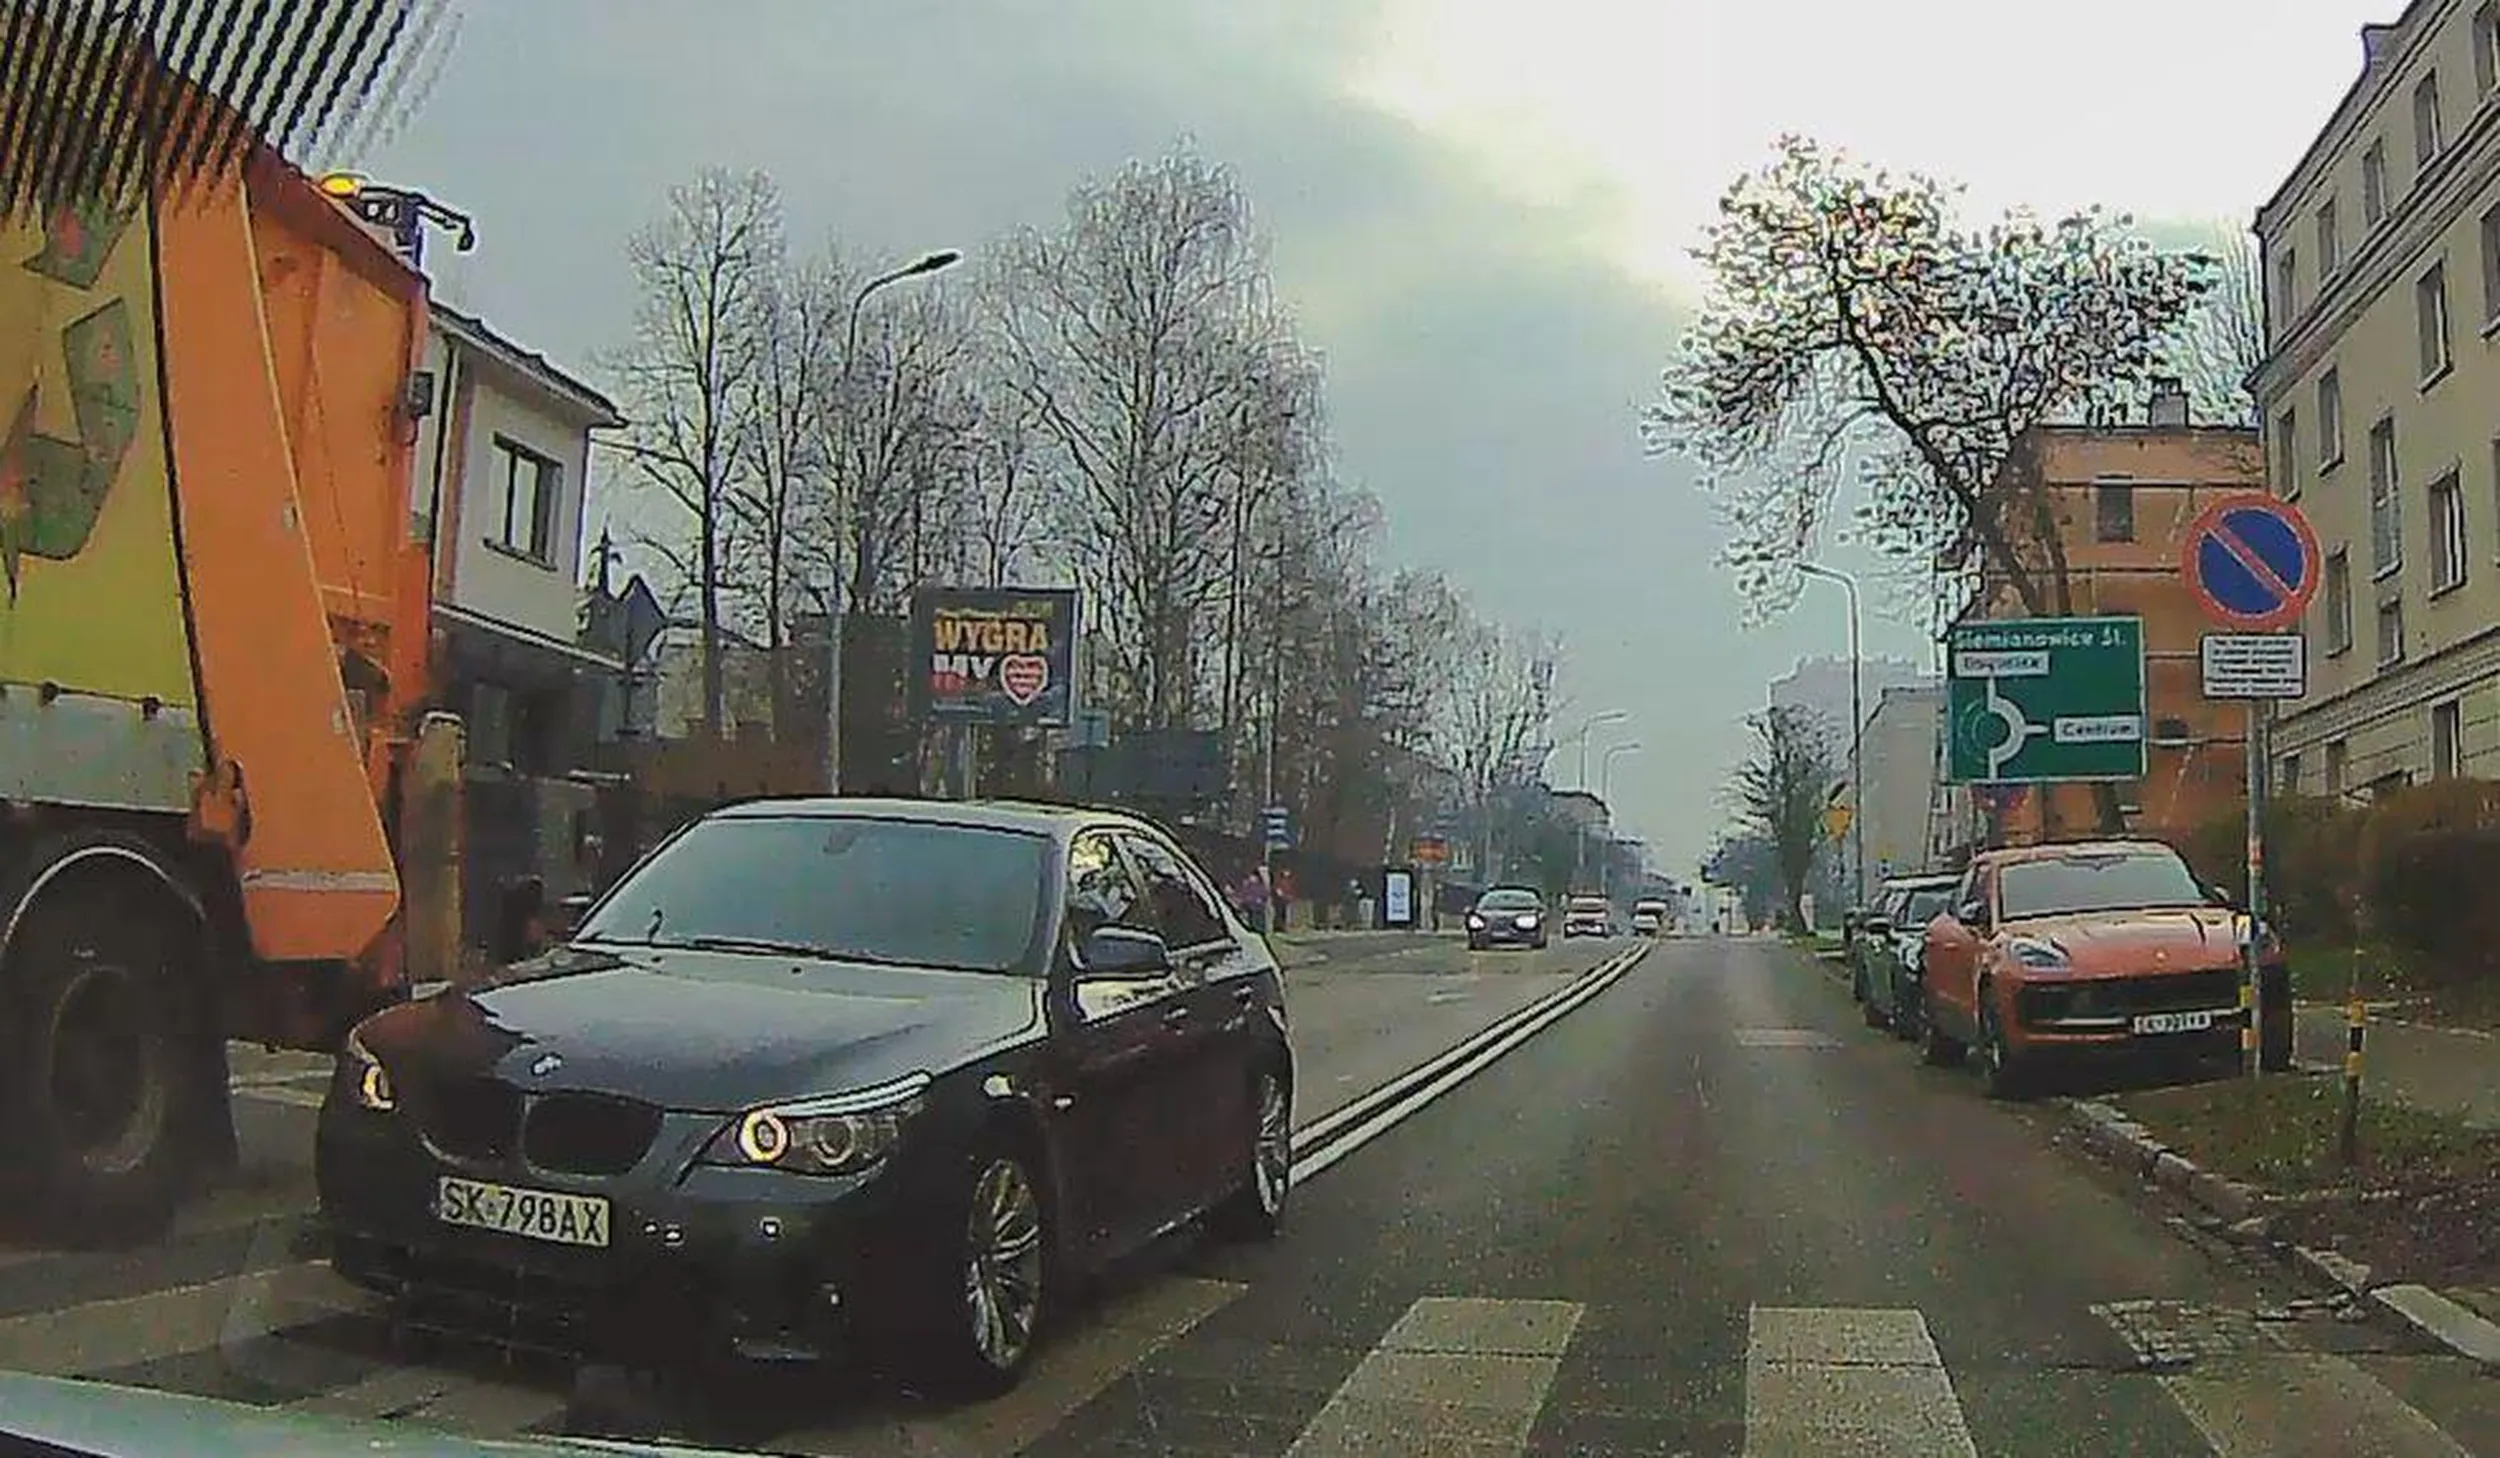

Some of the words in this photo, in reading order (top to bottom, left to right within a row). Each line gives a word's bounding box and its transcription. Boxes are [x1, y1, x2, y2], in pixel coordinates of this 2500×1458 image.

[934, 619, 1048, 653] WYGRA
[2062, 721, 2133, 738] Centrum
[445, 1182, 487, 1224] SK
[499, 1189, 602, 1243] 798AX
